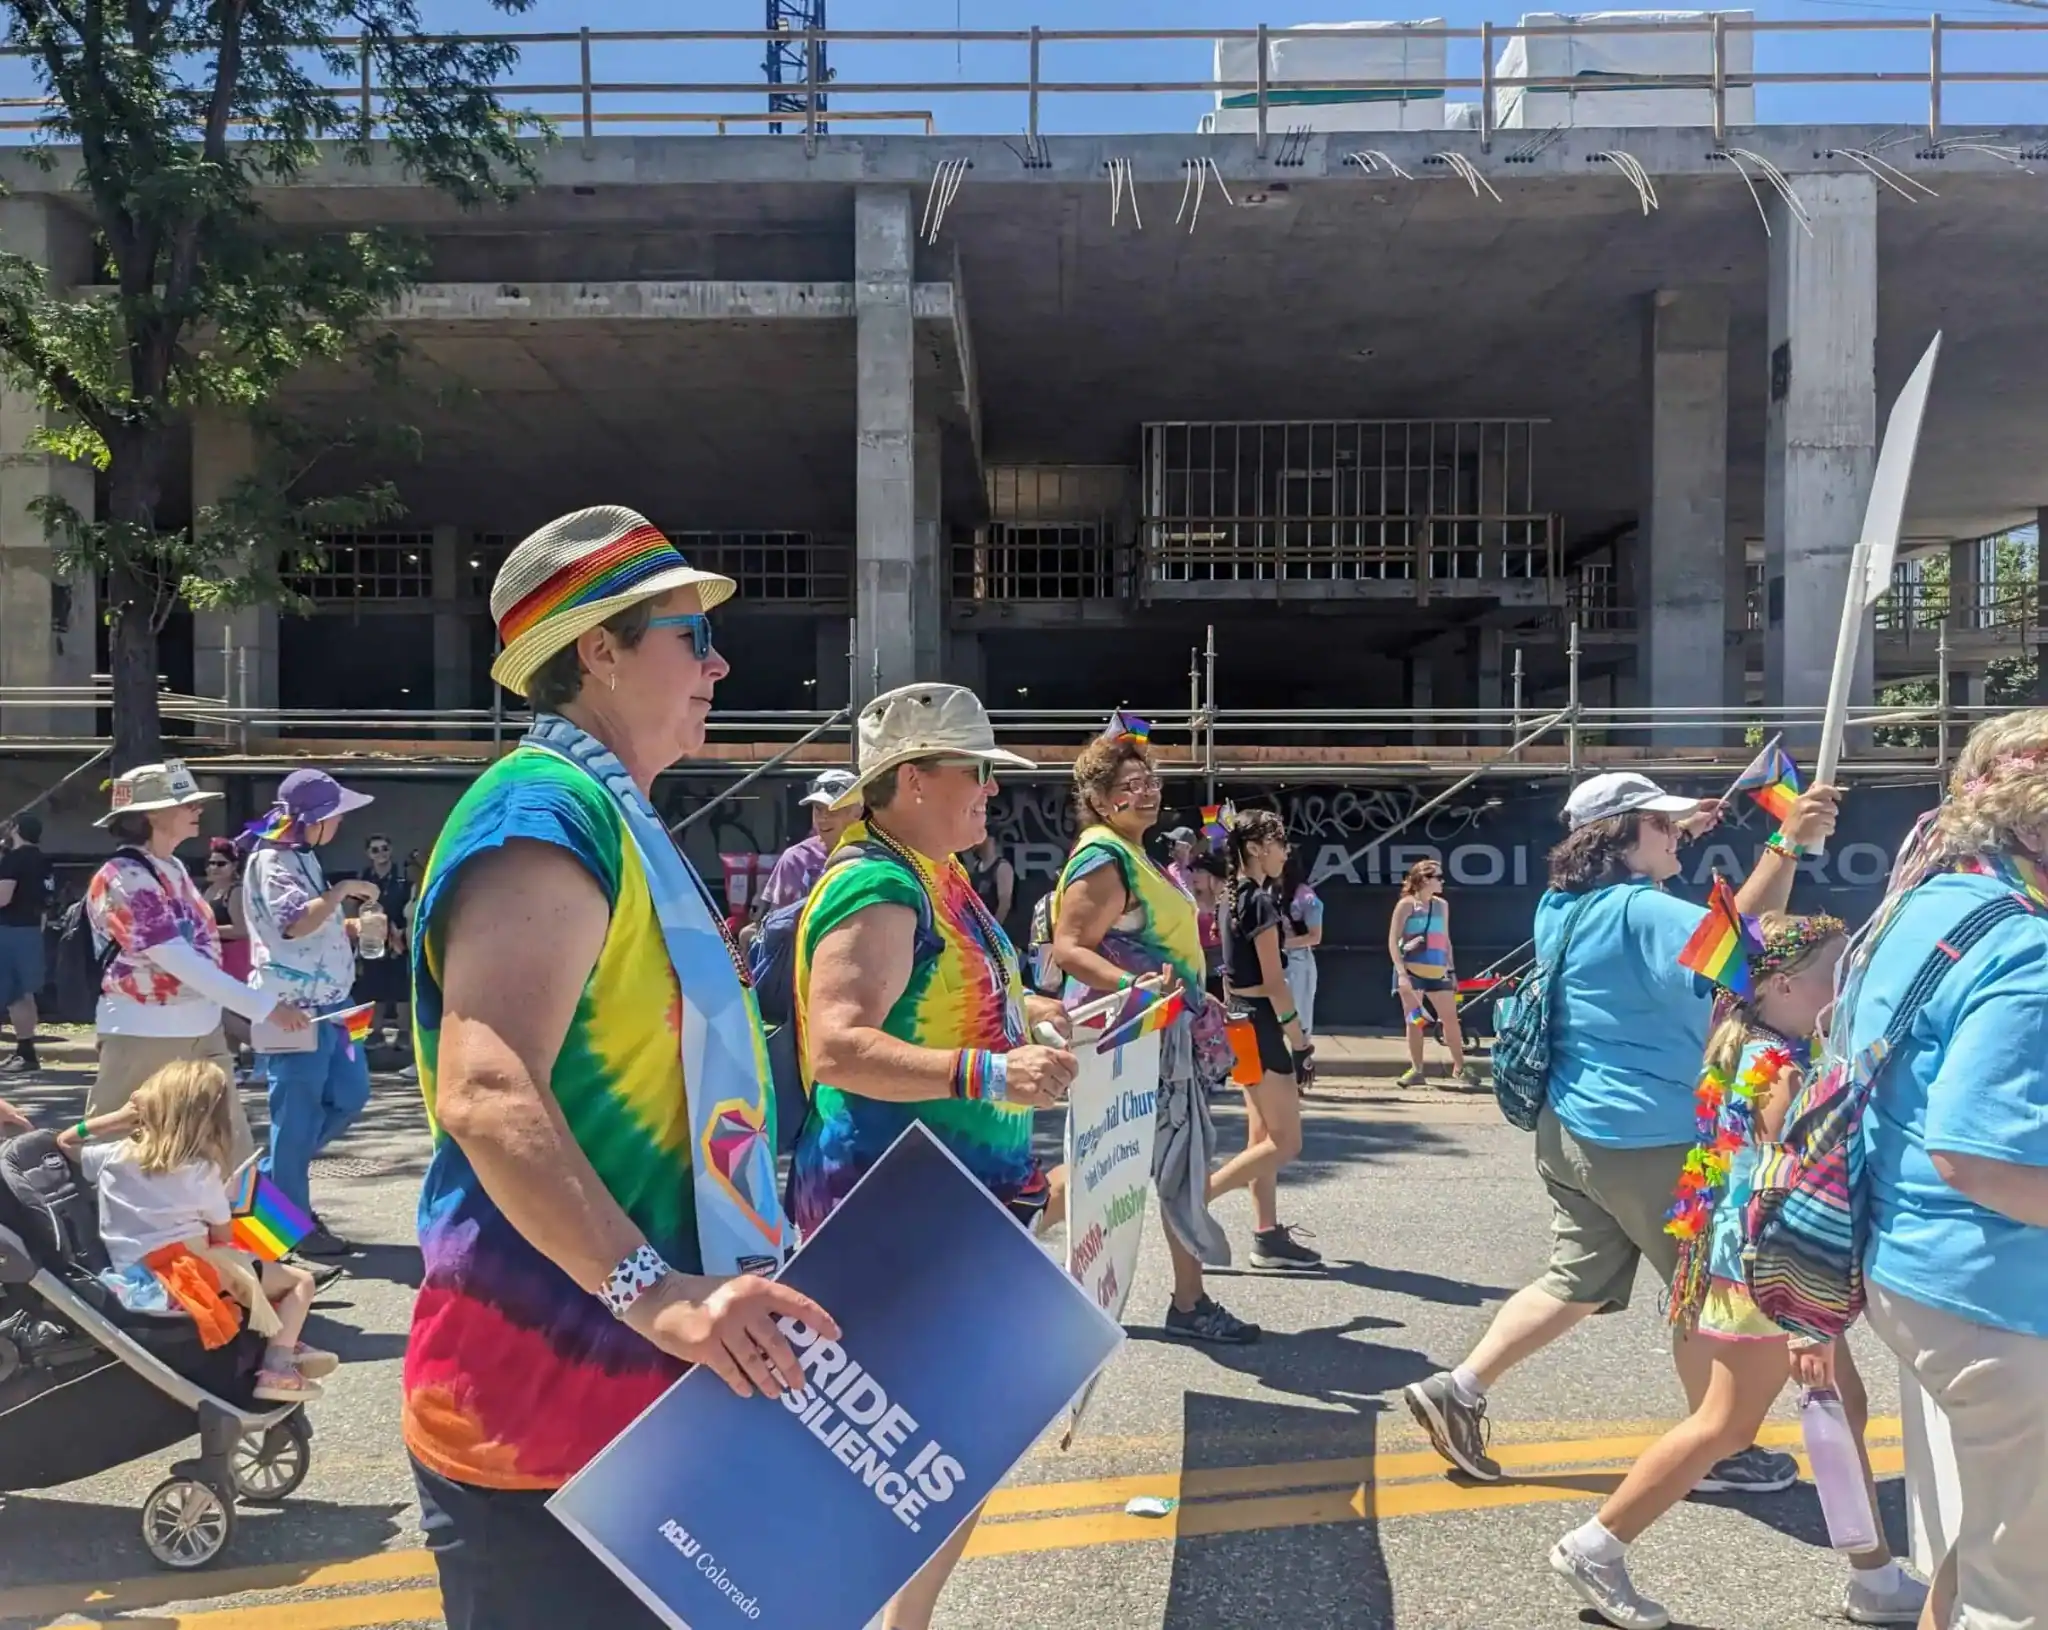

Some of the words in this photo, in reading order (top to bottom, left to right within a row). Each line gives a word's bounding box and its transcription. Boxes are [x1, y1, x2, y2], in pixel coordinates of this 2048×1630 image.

[1291, 844, 1526, 885] AIROI
[1122, 1090, 1158, 1122] Chur
[1115, 1139, 1139, 1163] Christ
[776, 1314, 920, 1458] PRIDE
[904, 1439, 966, 1502] IS
[774, 1372, 928, 1533] SILIENCE.
[658, 1518, 700, 1559] ACLU
[696, 1552, 761, 1620] Colorado
